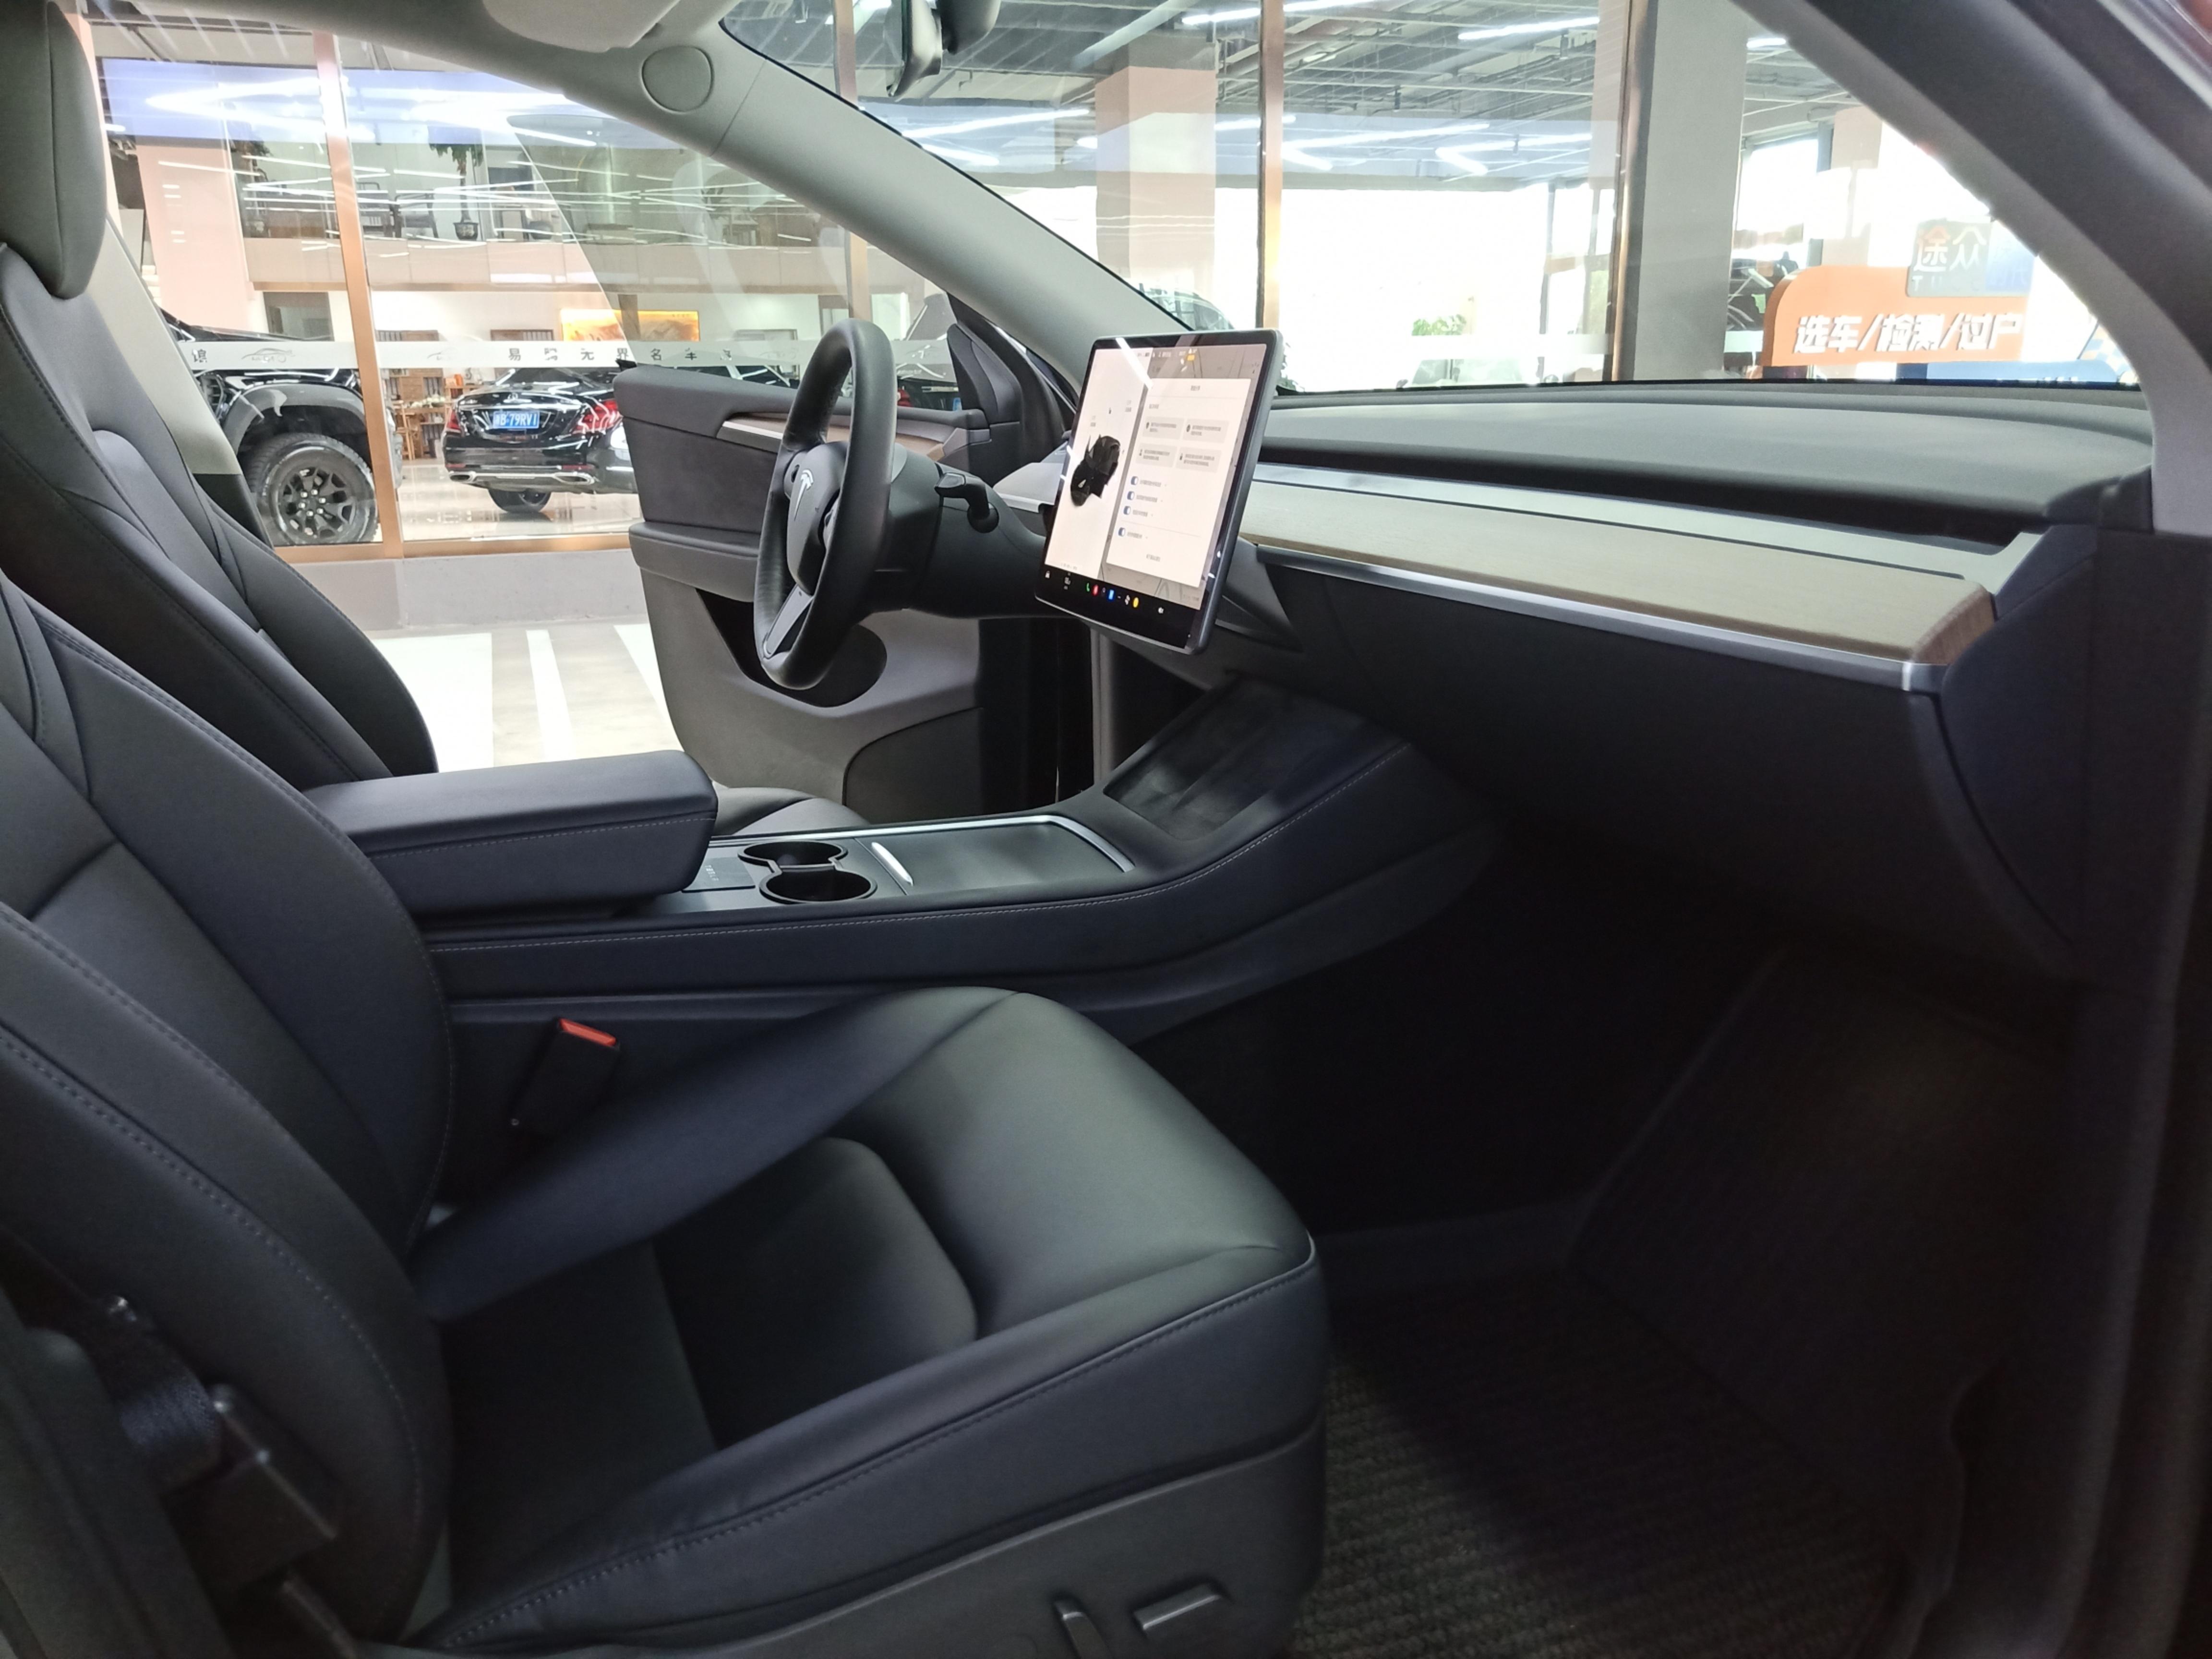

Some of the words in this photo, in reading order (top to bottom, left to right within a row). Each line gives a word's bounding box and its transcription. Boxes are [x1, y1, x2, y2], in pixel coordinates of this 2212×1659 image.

[1913, 225, 1987, 272] 途众
[1793, 312, 2023, 354] 选车/检测/过户
